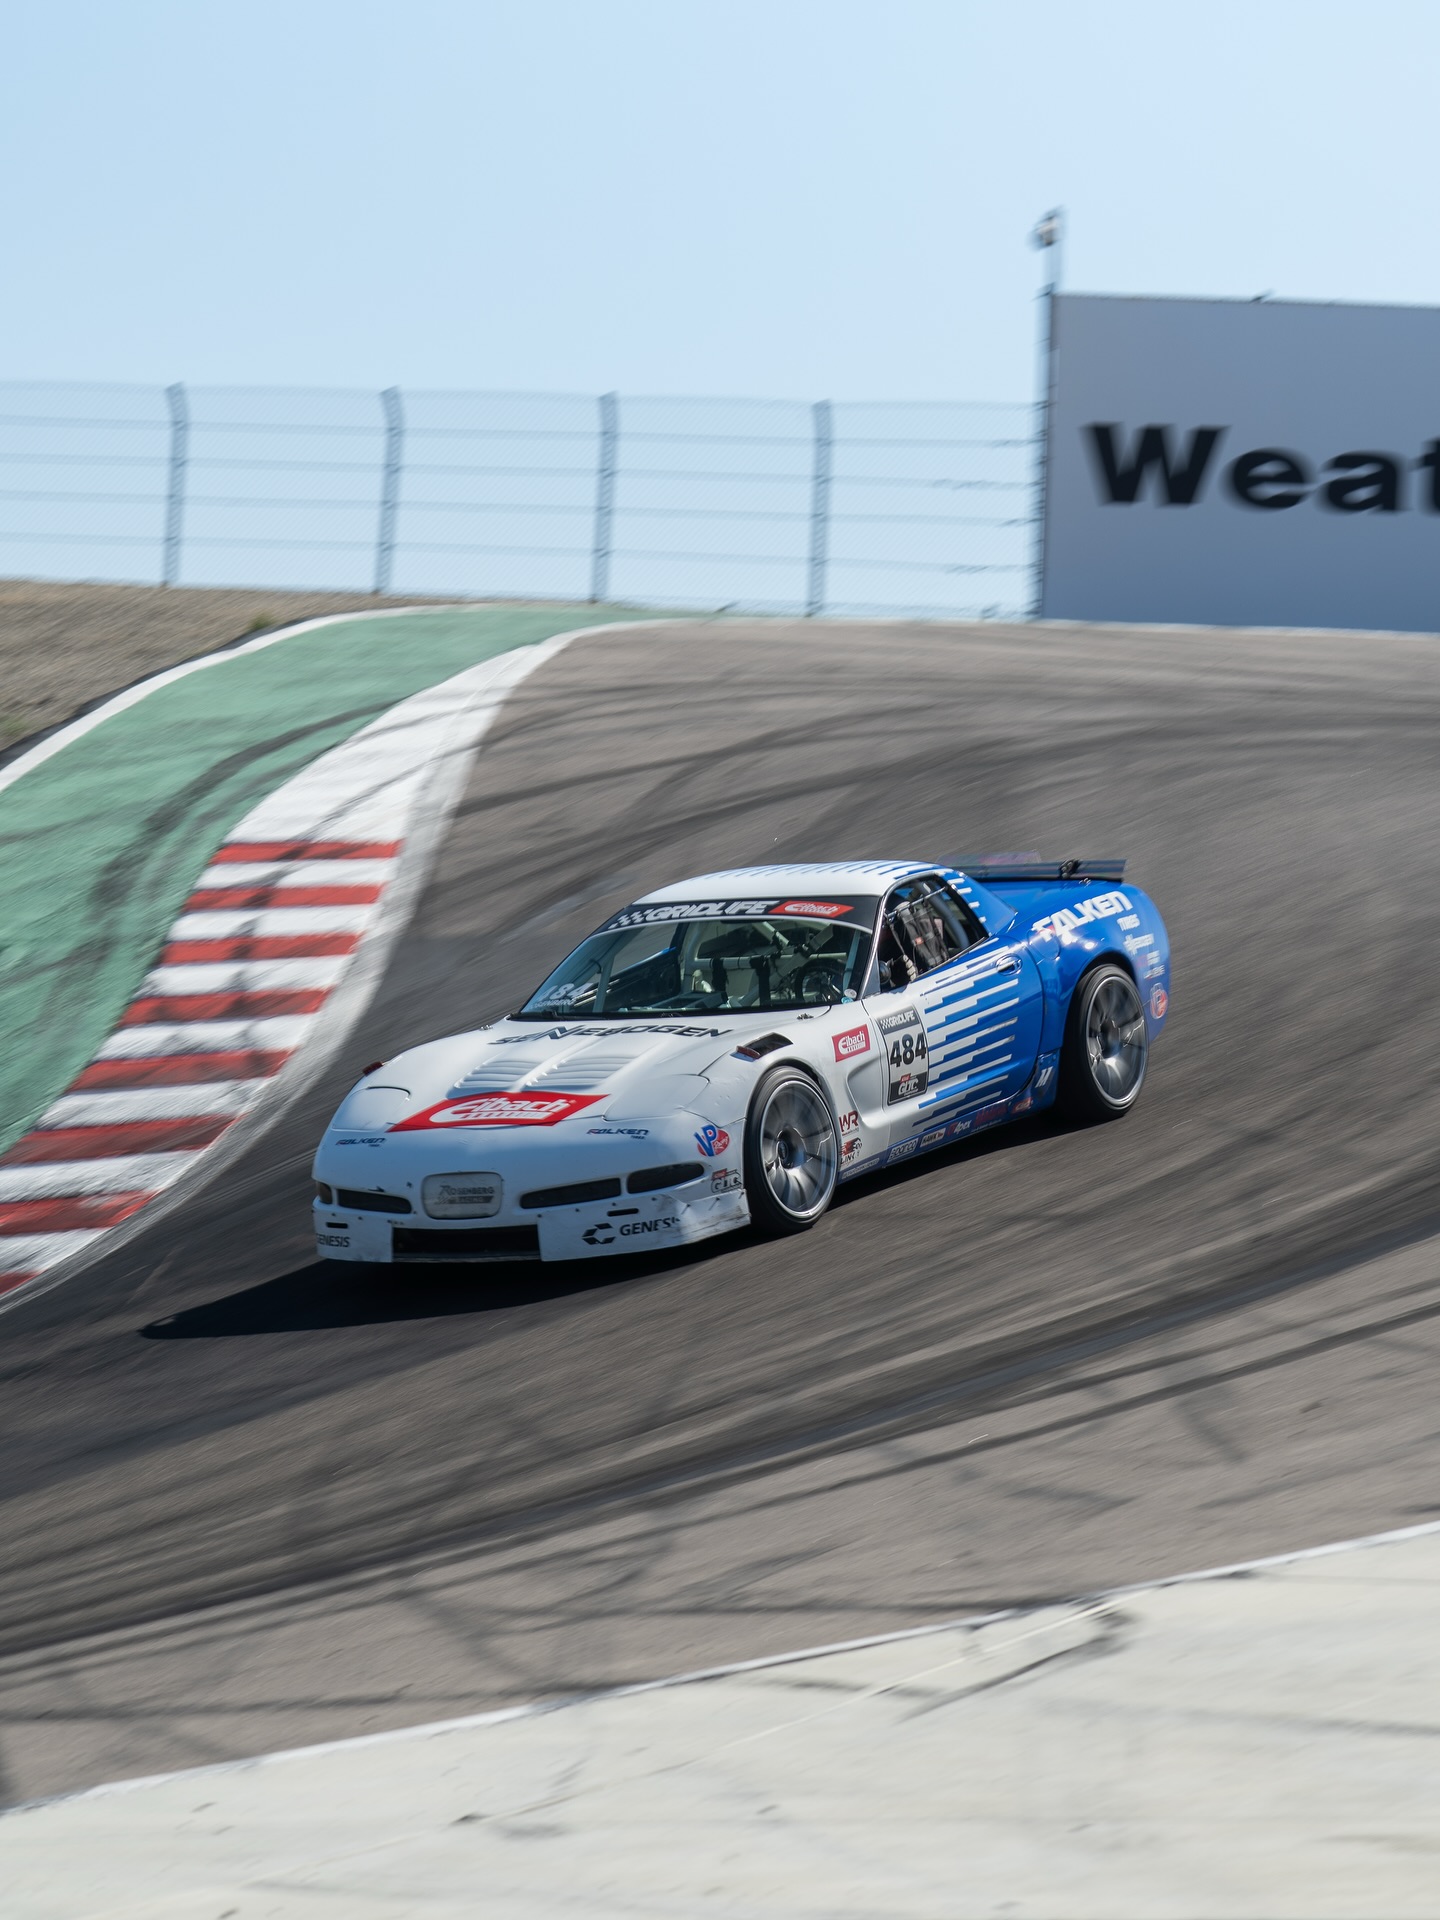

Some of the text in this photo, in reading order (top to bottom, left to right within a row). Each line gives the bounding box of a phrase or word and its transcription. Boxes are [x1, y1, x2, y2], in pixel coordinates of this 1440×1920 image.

[645, 900, 780, 921] GRIDLIFE
[1032, 890, 1133, 945] FALKEN
[888, 1010, 915, 1027] GRIDLIFE
[838, 1030, 866, 1055] Eibach
[889, 1032, 927, 1068] 484
[430, 1096, 571, 1123] Eibach
[335, 1137, 386, 1146] FALKEN
[694, 1124, 717, 1157] VP
